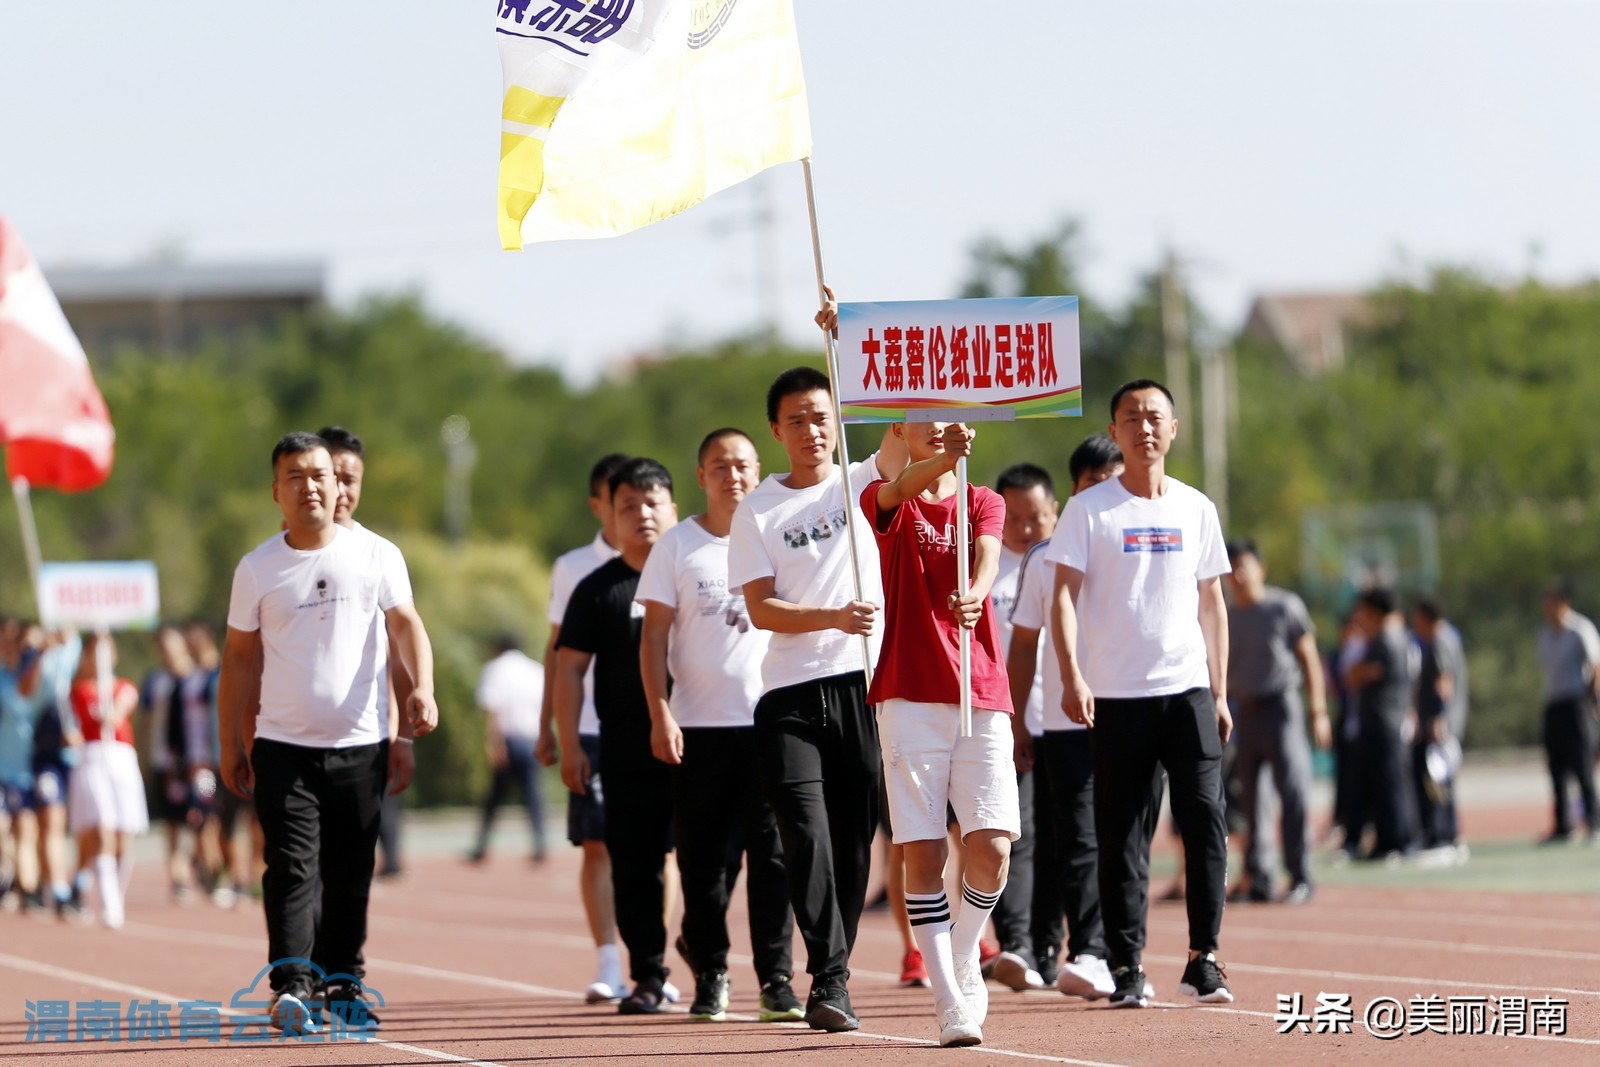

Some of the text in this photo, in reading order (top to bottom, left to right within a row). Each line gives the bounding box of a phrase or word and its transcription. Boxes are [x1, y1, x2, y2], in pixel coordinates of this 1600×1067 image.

[862, 322, 1057, 392] 大荔蔡伦纸业足球队
